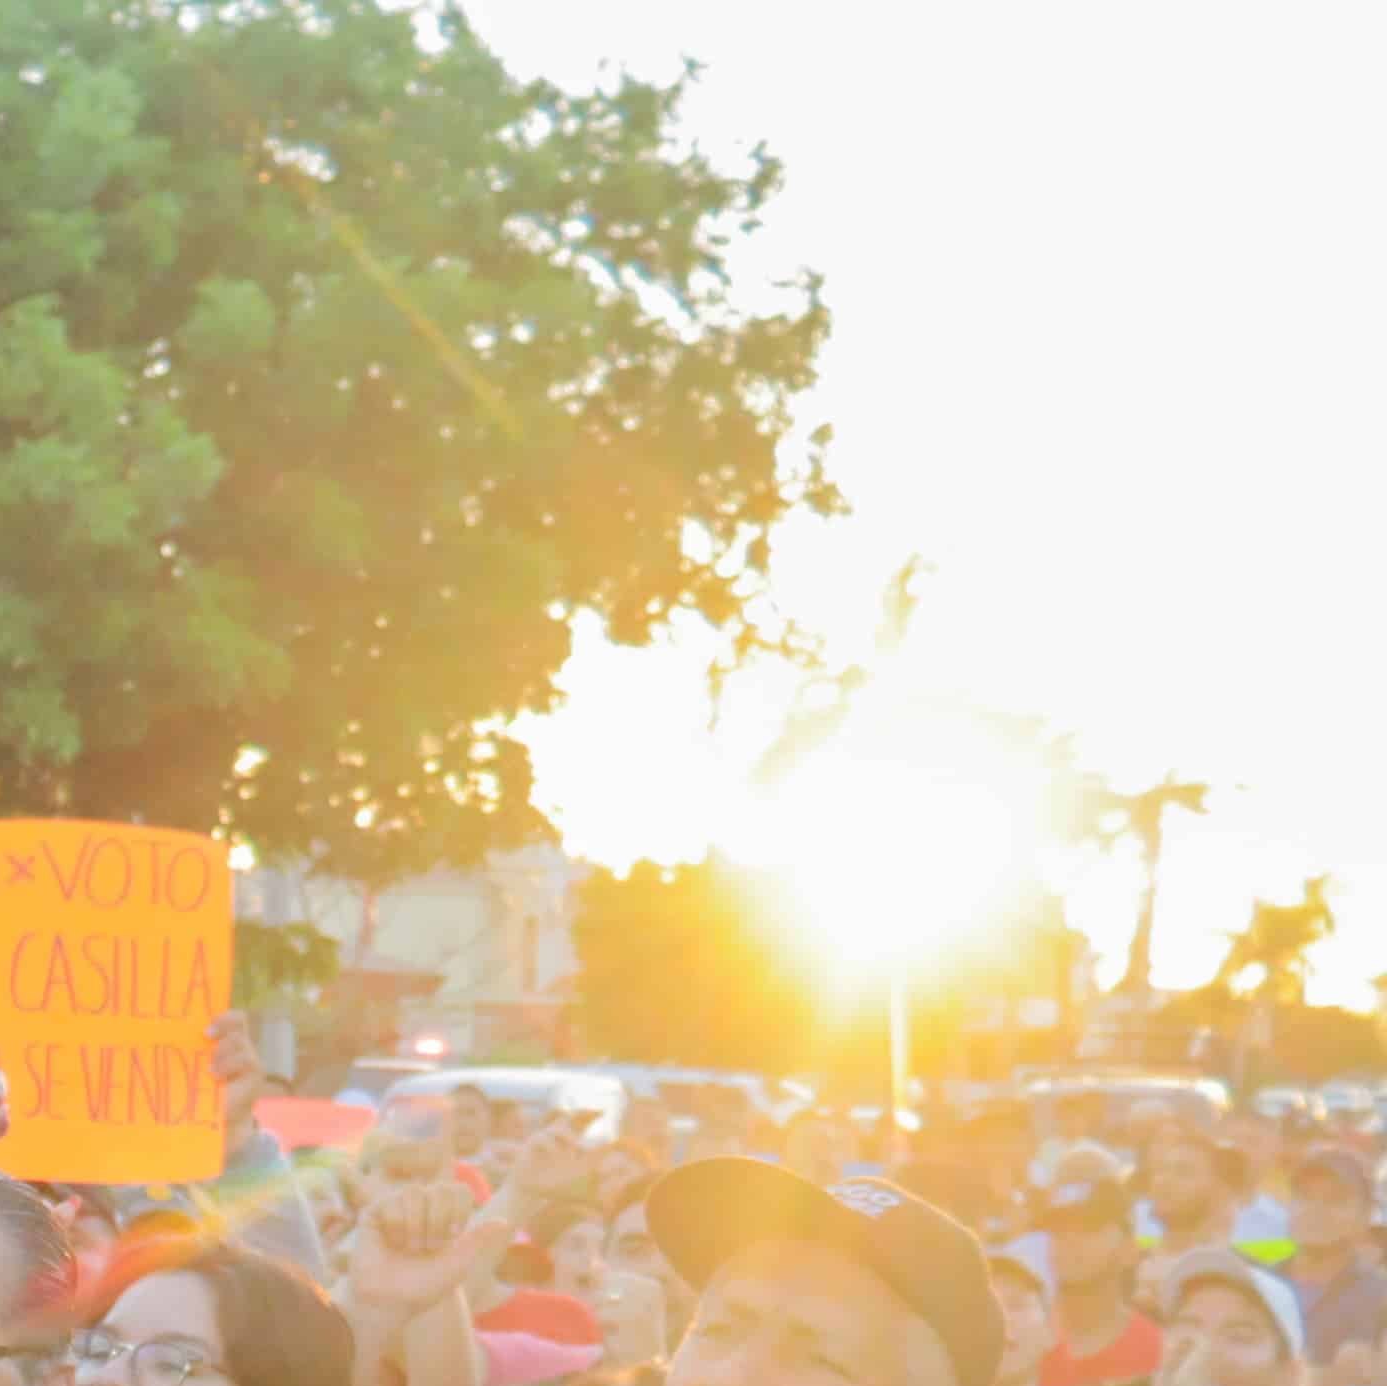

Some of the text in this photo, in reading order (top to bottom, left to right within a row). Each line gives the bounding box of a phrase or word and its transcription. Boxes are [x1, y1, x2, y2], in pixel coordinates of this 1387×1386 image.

[38, 836, 215, 914] VOTO
[9, 931, 215, 1020] CASILLA
[23, 1041, 67, 1121] SE
